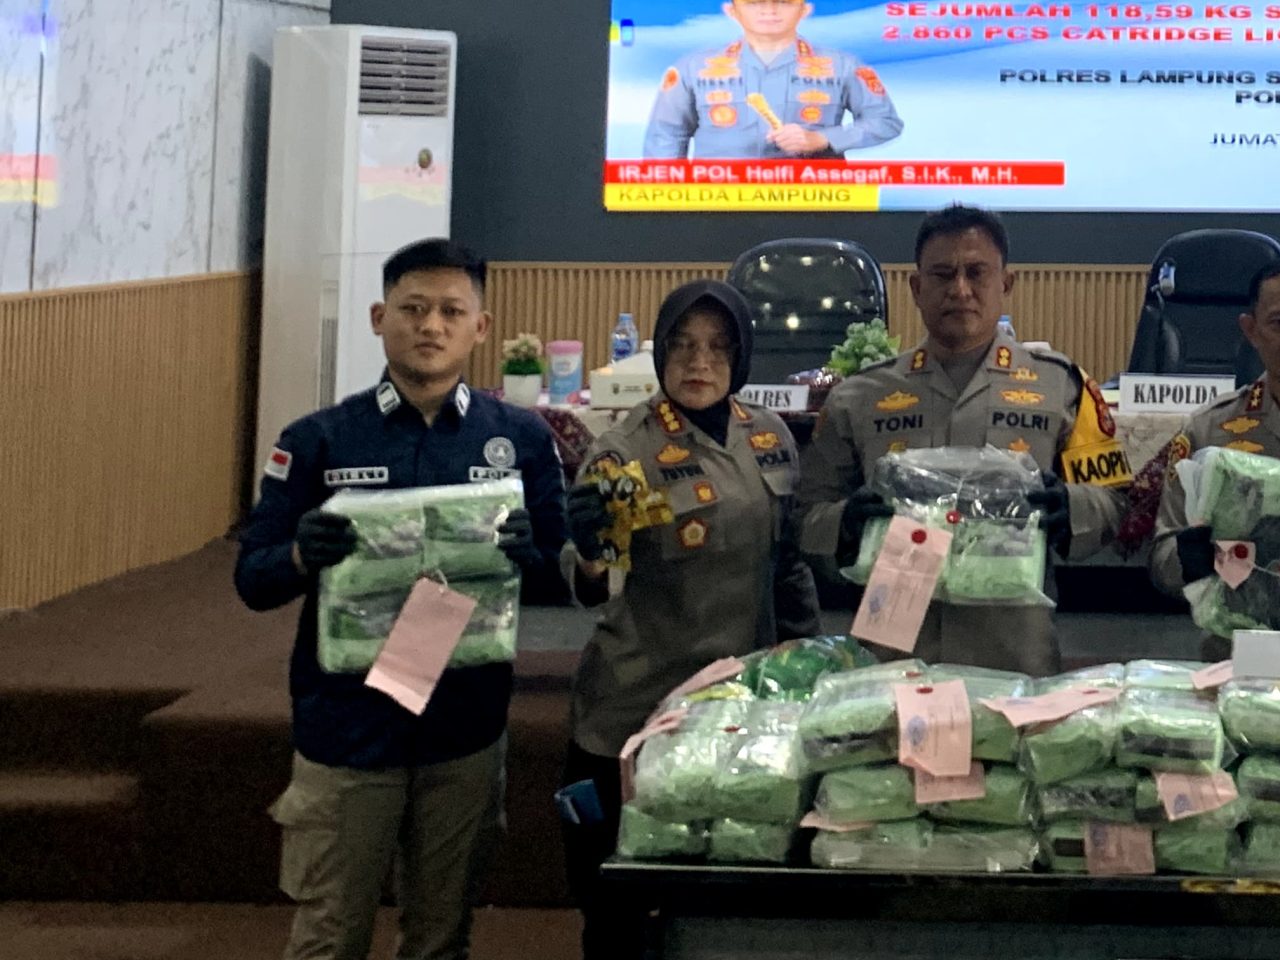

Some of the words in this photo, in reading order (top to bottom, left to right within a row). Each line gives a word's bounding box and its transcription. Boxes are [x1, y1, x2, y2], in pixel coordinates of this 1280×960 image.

[885, 2, 1071, 18] SEJUMLAH
[1086, 3, 1194, 21] 118,59
[1204, 4, 1252, 20] KG
[882, 25, 971, 41] 2.860
[984, 25, 1050, 41] PCS
[1062, 26, 1233, 42] CATRIDGE
[1000, 69, 1111, 83] POLRES
[1120, 70, 1256, 85] LAMPUNG
[618, 165, 689, 182] IRJEN
[693, 165, 739, 181] POL
[746, 165, 795, 181] Helfi
[618, 188, 729, 202] KAPOLDA
[737, 188, 850, 203] LAMPUNG
[1133, 383, 1219, 404] KAPOLDA
[873, 413, 924, 433] TONI
[992, 411, 1049, 431] POLRI
